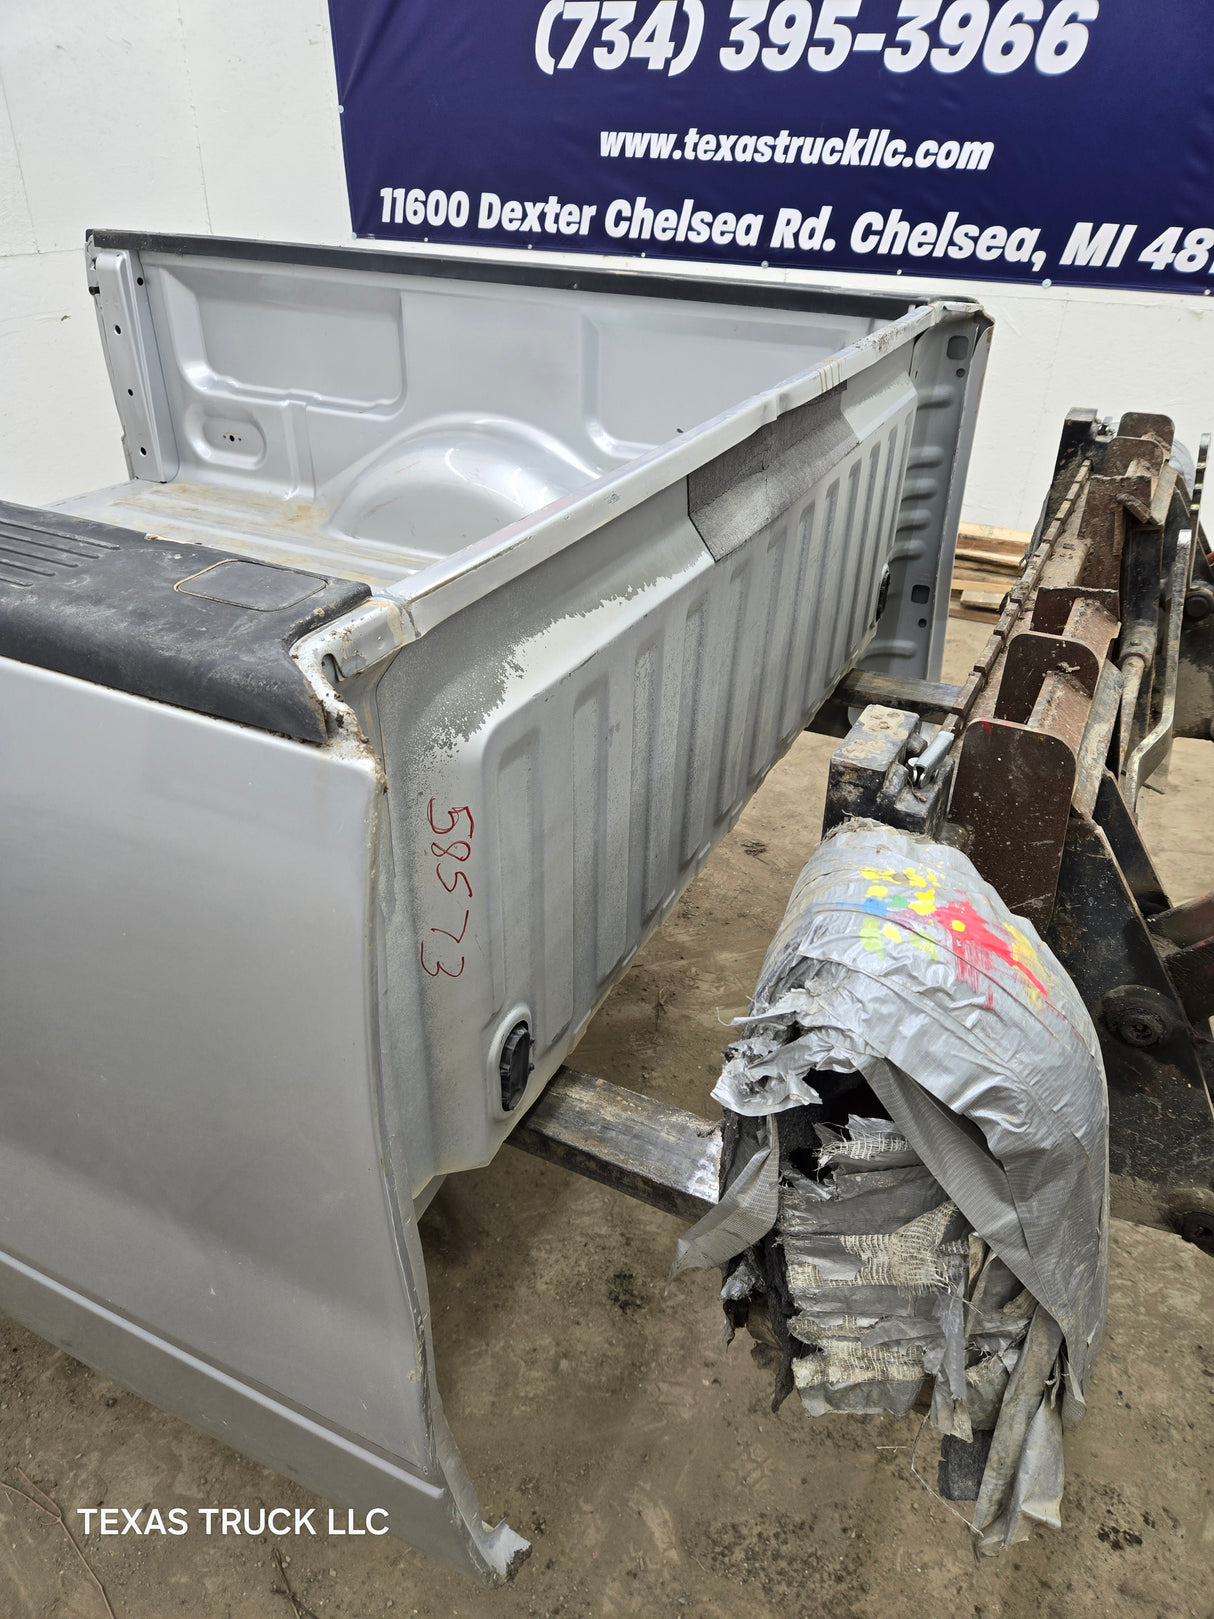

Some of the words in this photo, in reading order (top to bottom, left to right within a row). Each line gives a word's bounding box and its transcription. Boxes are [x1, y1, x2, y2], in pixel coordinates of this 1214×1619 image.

[535, 0, 705, 77] (734)
[719, 0, 1099, 75] 395-3966
[600, 128, 994, 170] www.texastruckllc.com
[380, 187, 470, 228] 11600
[477, 192, 598, 236] Dexter
[604, 196, 765, 247] Chelsea
[770, 207, 836, 252] Rd.
[850, 208, 1047, 272] Chelsea,
[1058, 221, 1138, 268] MI
[1137, 226, 1214, 274] 48
